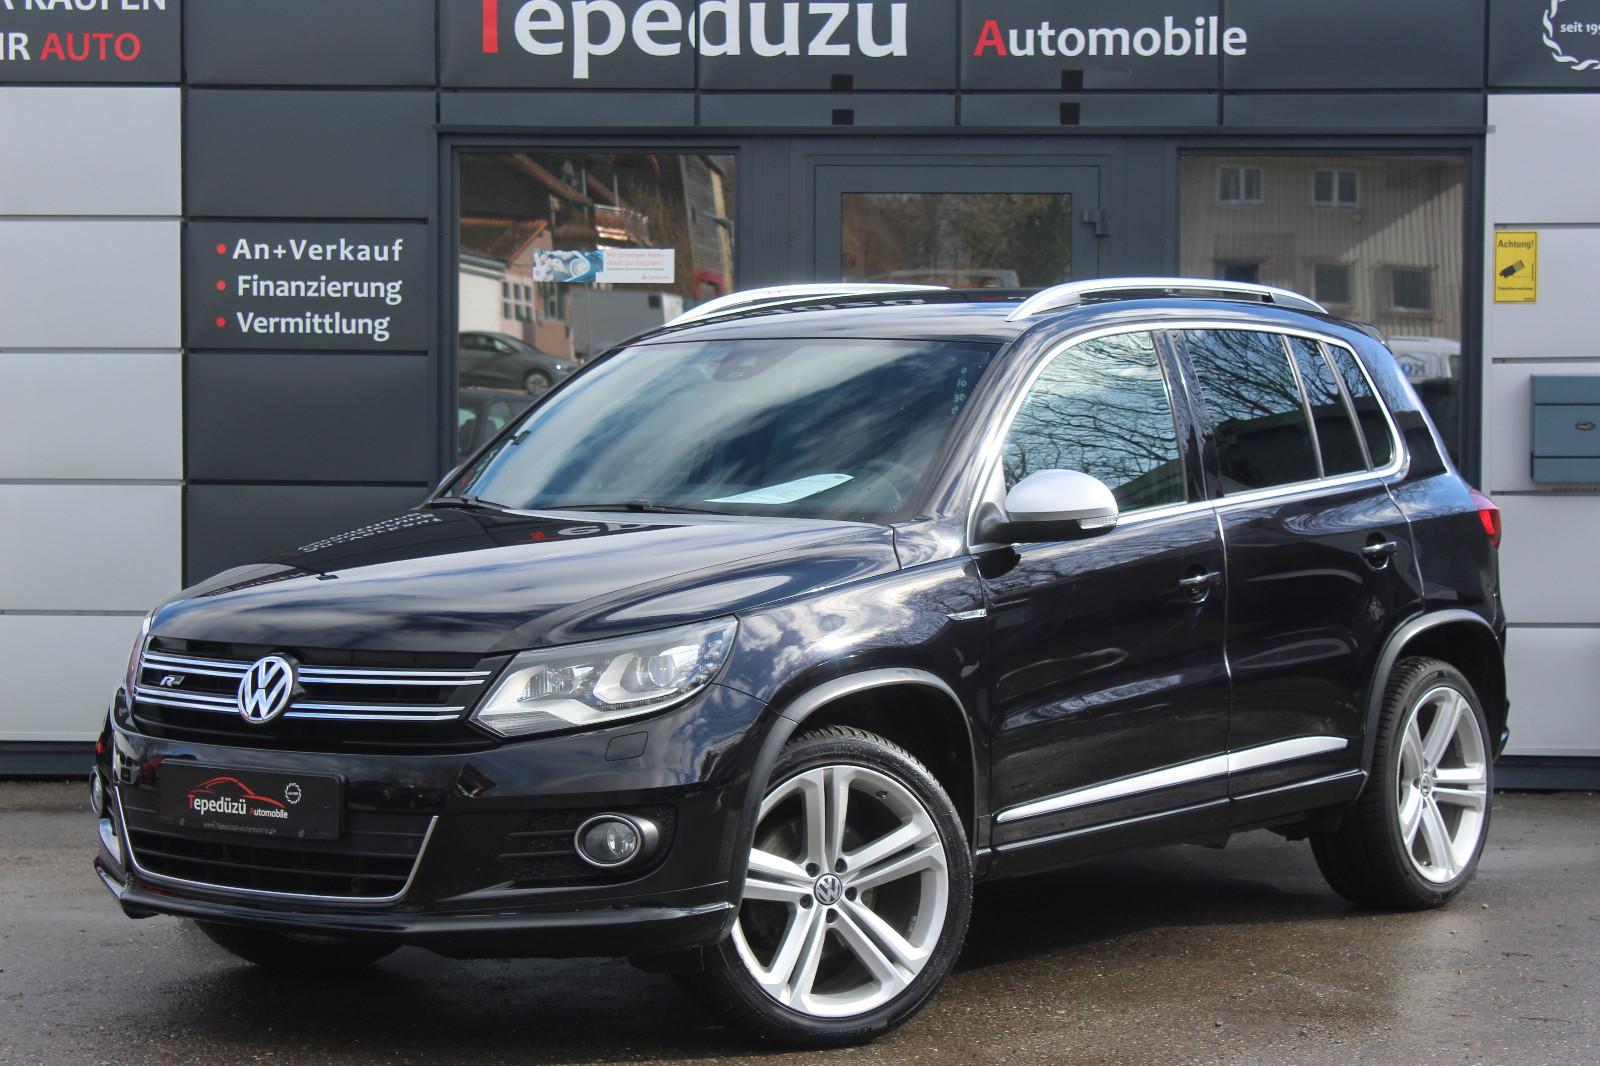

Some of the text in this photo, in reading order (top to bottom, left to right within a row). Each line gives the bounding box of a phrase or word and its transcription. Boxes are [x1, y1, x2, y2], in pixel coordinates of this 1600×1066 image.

[973, 16, 1248, 57] Automobile
[1560, 21, 1583, 33] seit
[40, 32, 142, 62] AUTO
[232, 238, 404, 262] An+Verkauf
[1498, 240, 1534, 250] Achtung!
[237, 275, 403, 305] Finanzierung
[237, 312, 391, 341] Vermittlung
[187, 794, 289, 819] Tepedüzü Automobile
